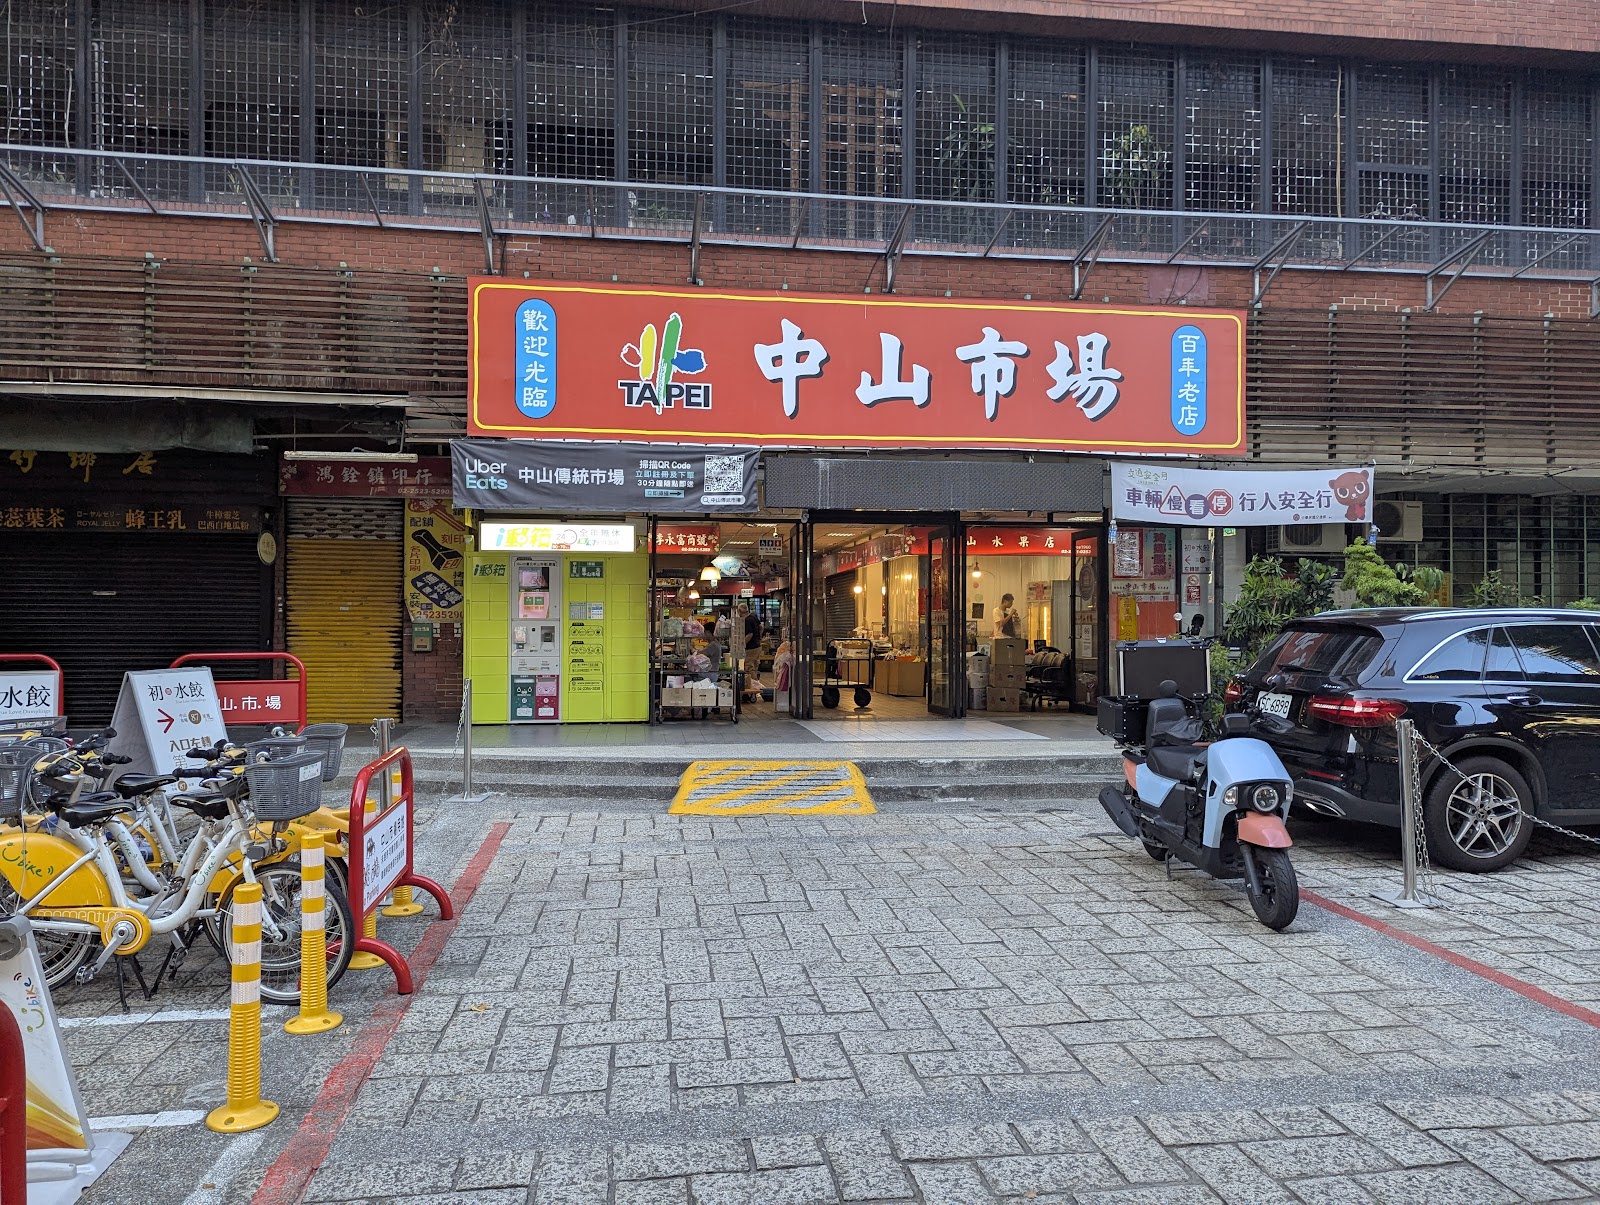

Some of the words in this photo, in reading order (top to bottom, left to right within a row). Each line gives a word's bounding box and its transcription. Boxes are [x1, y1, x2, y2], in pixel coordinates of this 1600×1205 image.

[522, 309, 549, 408] 歡迎光臨
[754, 318, 1124, 422] 中山市場
[1178, 334, 1200, 427] 百年老店
[618, 381, 711, 409] TAIPEI
[465, 458, 507, 475] Uber
[671, 461, 692, 470] Code
[316, 466, 433, 485] 鴻銓鎖印行
[465, 474, 508, 490] Eats
[518, 467, 625, 487] 中山傳統市場
[1128, 468, 1168, 482] 交通安全月
[1239, 489, 1333, 512] 行人安全行
[0, 506, 65, 529] 蕊葉茶
[126, 508, 187, 530] 蜂王乳
[410, 517, 434, 528] 配鎖
[441, 533, 465, 545] 刻印
[409, 545, 421, 572] 名片印刷
[474, 564, 506, 577] i郵箱
[1258, 697, 1290, 715] SC-6898
[190, 713, 199, 721] 87
[169, 736, 213, 753] 入口左轉
